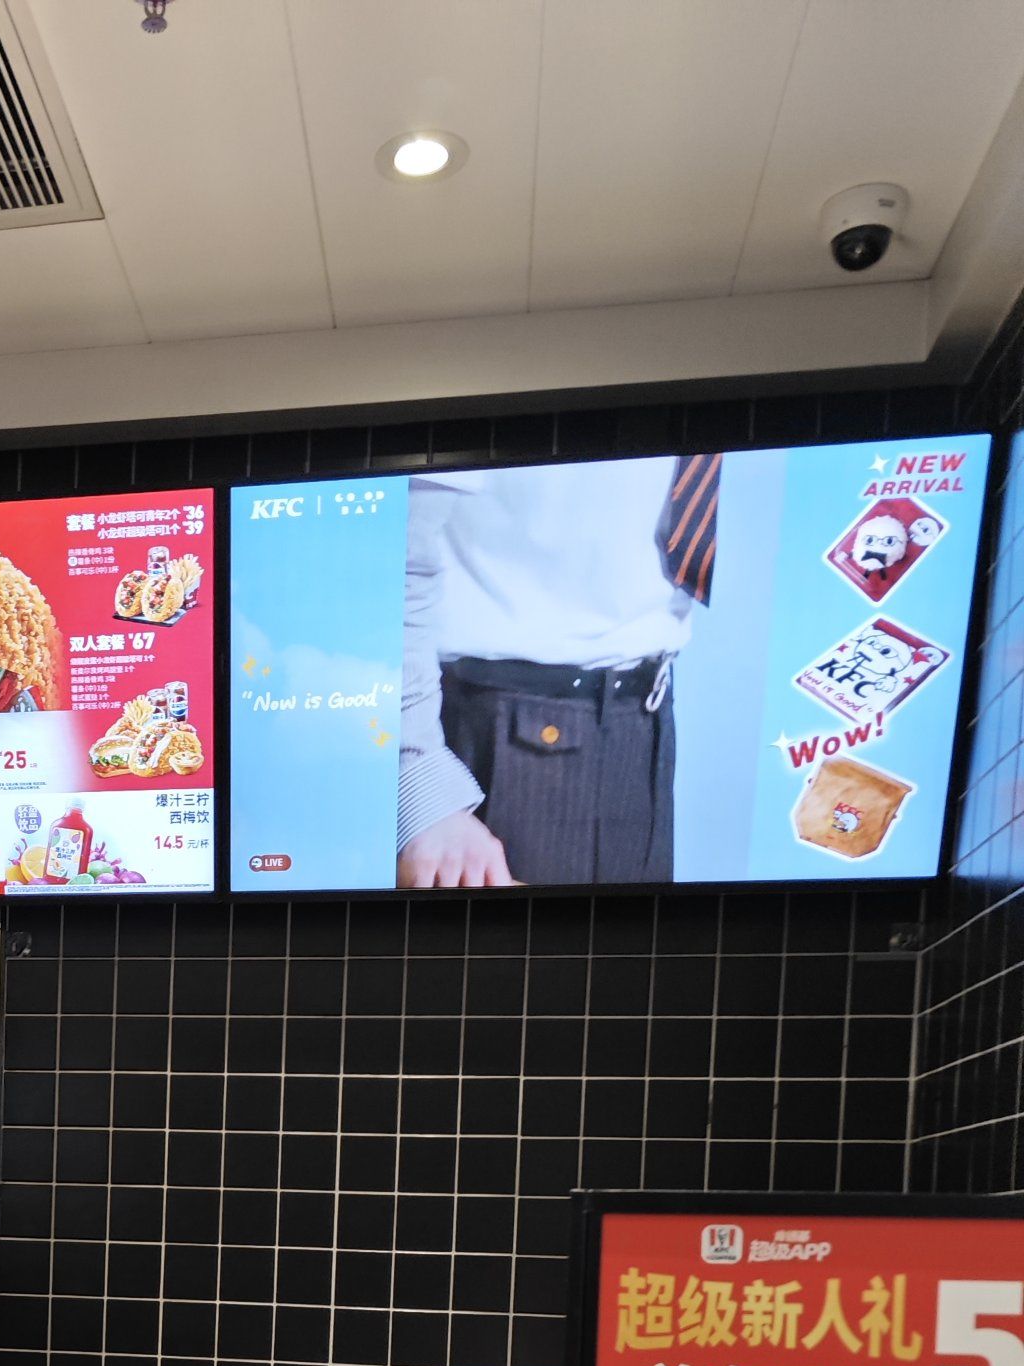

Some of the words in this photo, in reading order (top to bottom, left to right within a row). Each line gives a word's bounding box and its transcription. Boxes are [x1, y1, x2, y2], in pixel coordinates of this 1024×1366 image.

[896, 453, 967, 475] NEW
[863, 477, 966, 497] ARRIVAL
[250, 497, 304, 520] KFC
[66, 514, 95, 532] 套餐
[69, 634, 125, 652] 双人套餐
[816, 658, 877, 698] KFC
[304, 692, 322, 709] is
[156, 793, 210, 808] 爆汁三柠
[169, 810, 210, 824] 西梅饮
[154, 835, 184, 850] 14.5
[264, 858, 283, 867] LIVE
[614, 1267, 923, 1362] 超级新人礼
